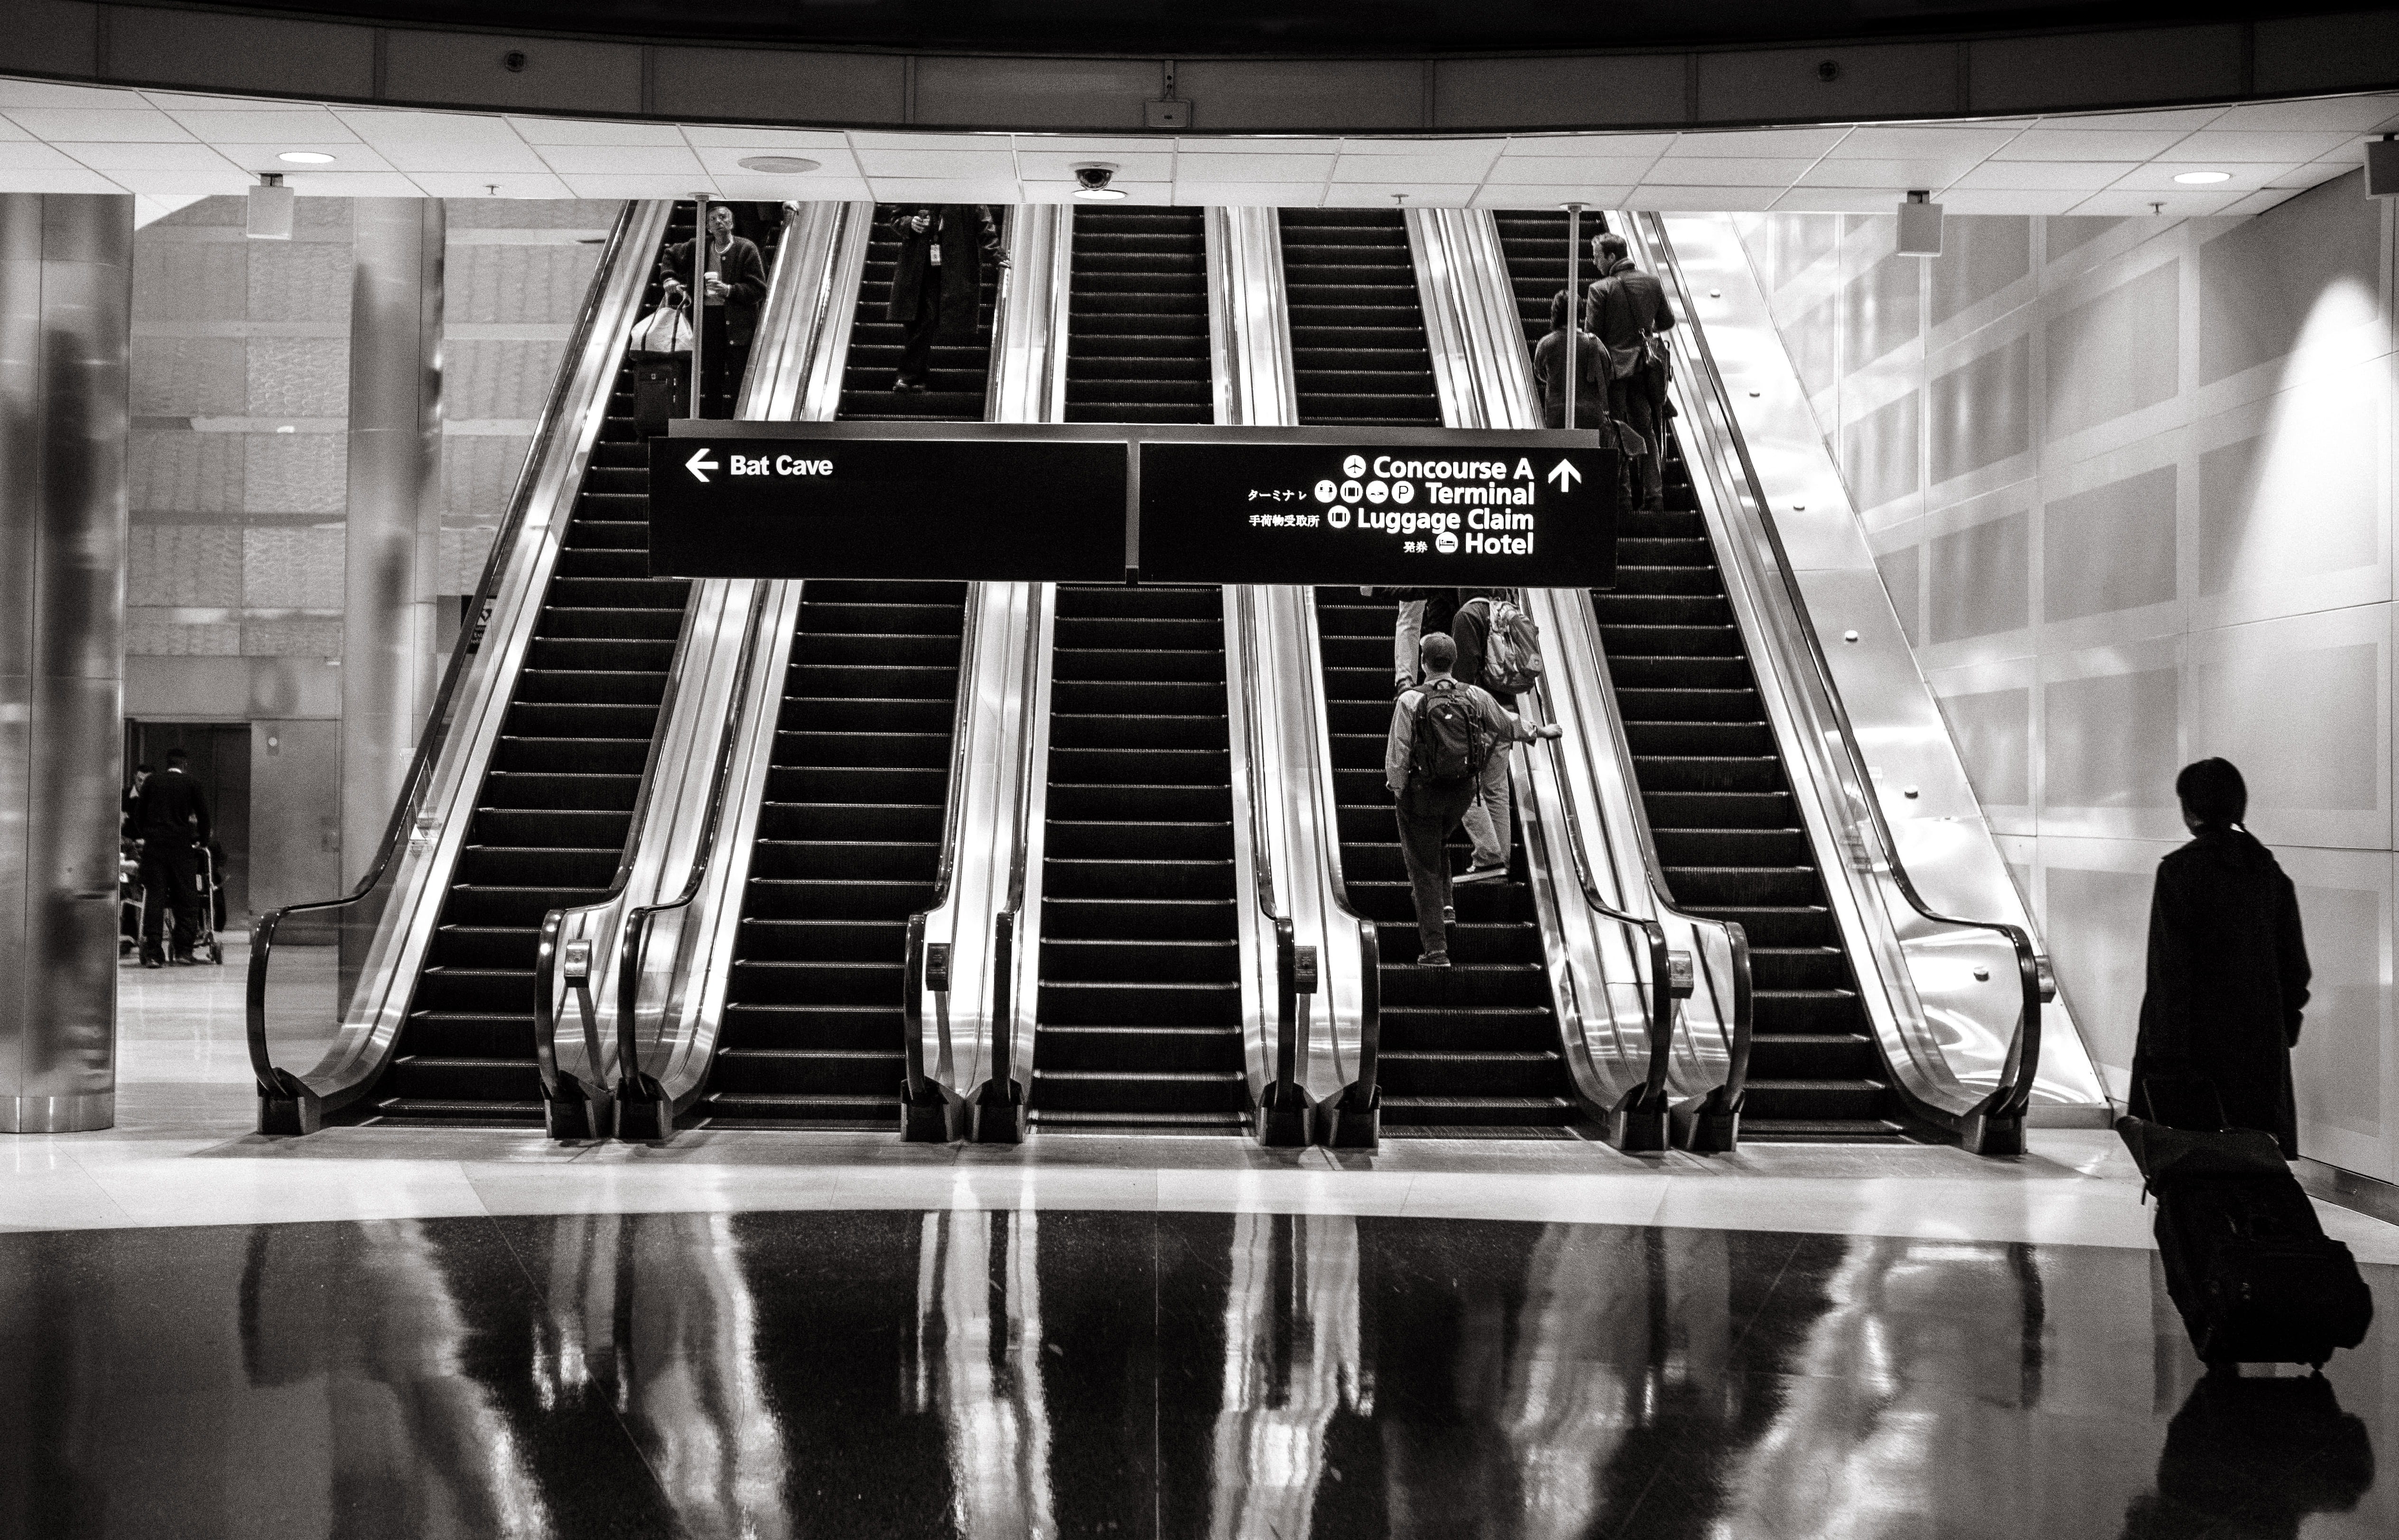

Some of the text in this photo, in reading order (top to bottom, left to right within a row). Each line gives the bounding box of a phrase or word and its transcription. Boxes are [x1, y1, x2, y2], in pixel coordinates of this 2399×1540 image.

[731, 455, 833, 475] Bat Cave
[1373, 455, 1534, 480] Concourse A
[1425, 482, 1534, 505] Terminal
[1248, 514, 1320, 528] 手荷物受取所
[1358, 507, 1534, 534] Luggage Claim
[1465, 531, 1534, 555] Hotel
